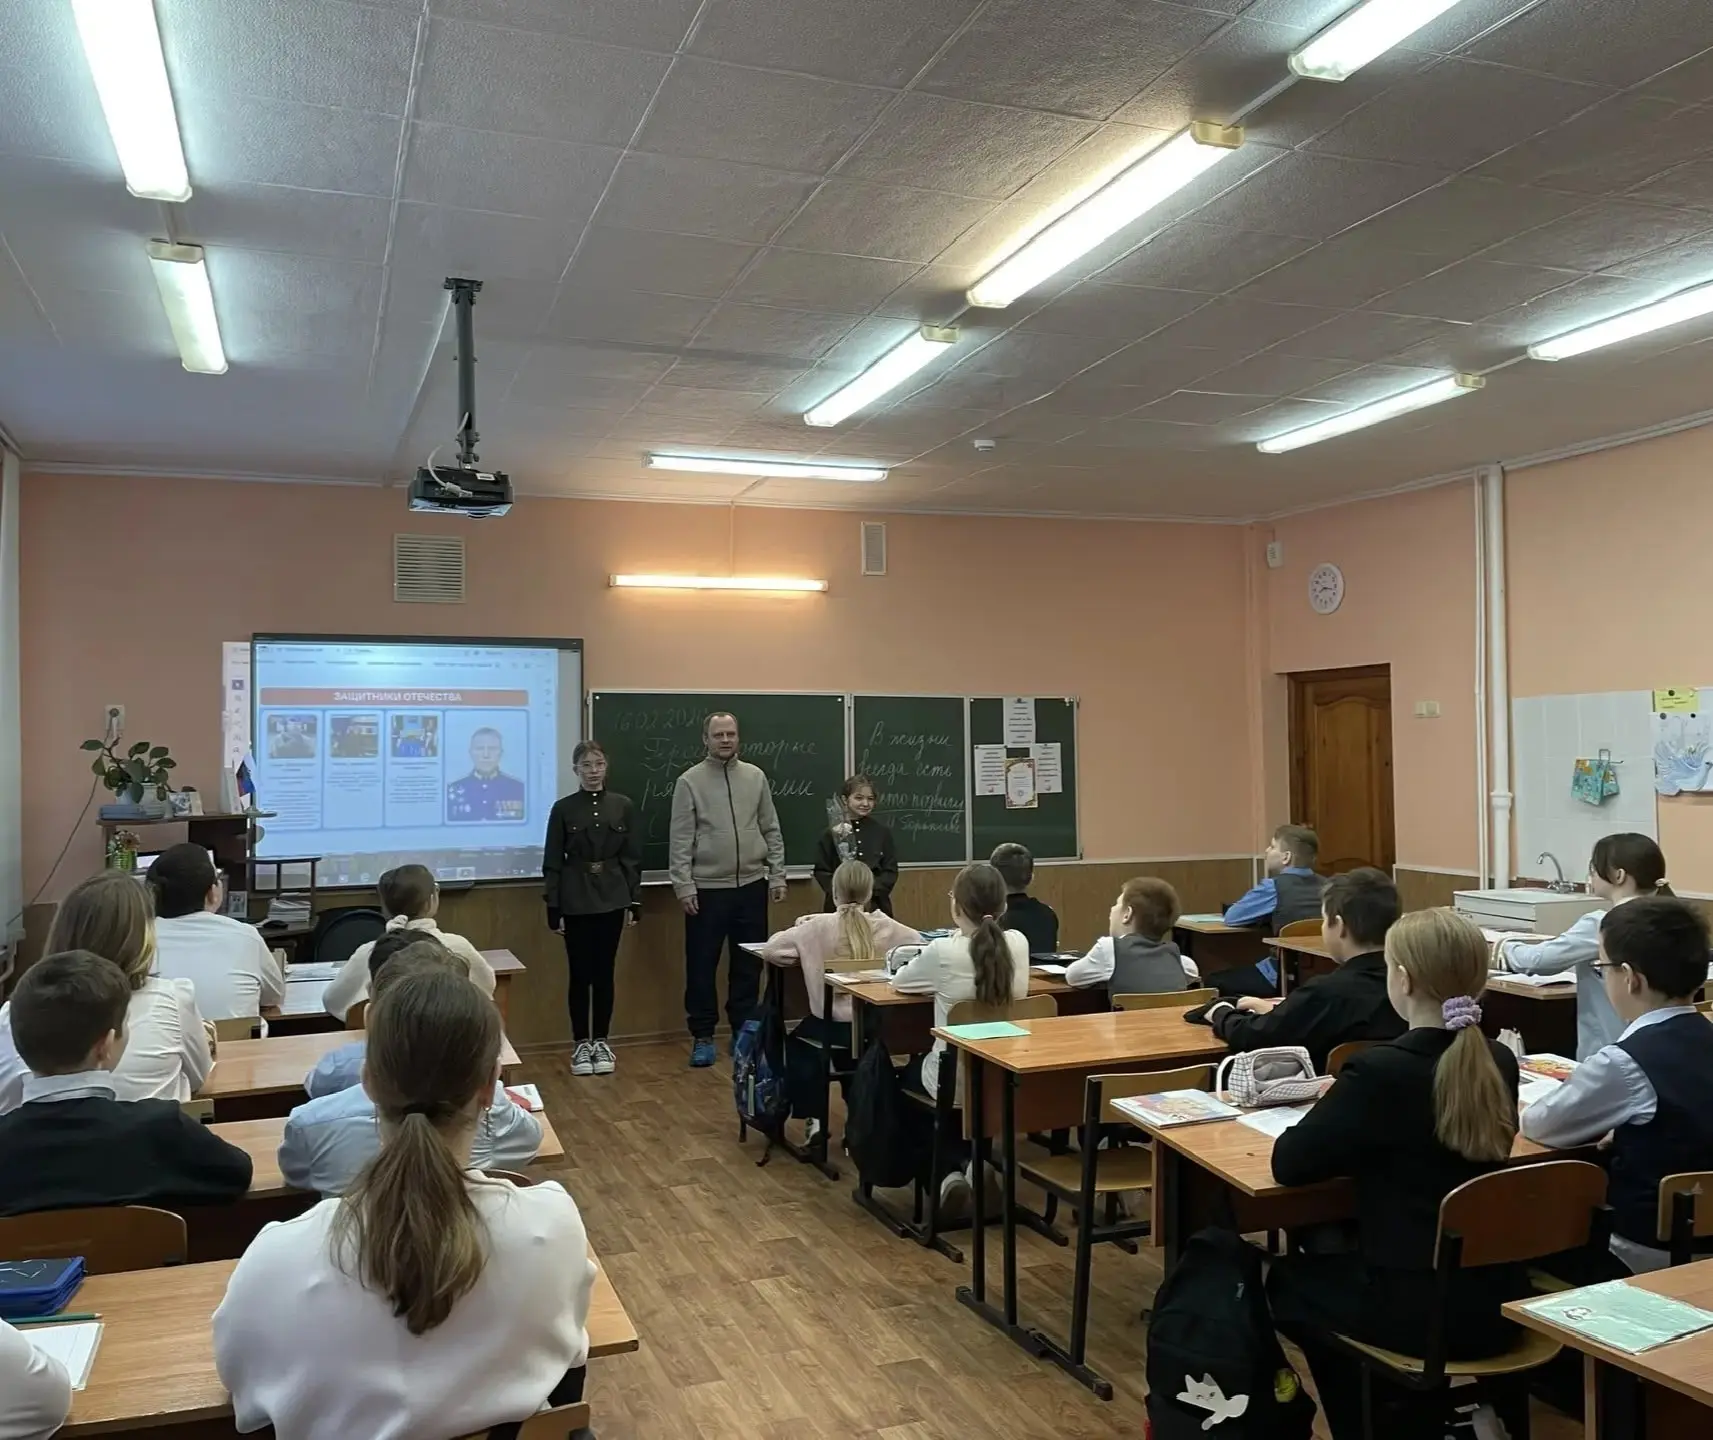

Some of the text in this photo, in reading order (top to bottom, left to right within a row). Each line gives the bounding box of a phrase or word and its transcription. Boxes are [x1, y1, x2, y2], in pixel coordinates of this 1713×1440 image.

[333, 691, 463, 702] ЗАЩИТНИКИ ОТЕЧЕСТВА
[869, 720, 954, 760] В жизни
[738, 739, 818, 770] оторые
[768, 777, 816, 797] ами
